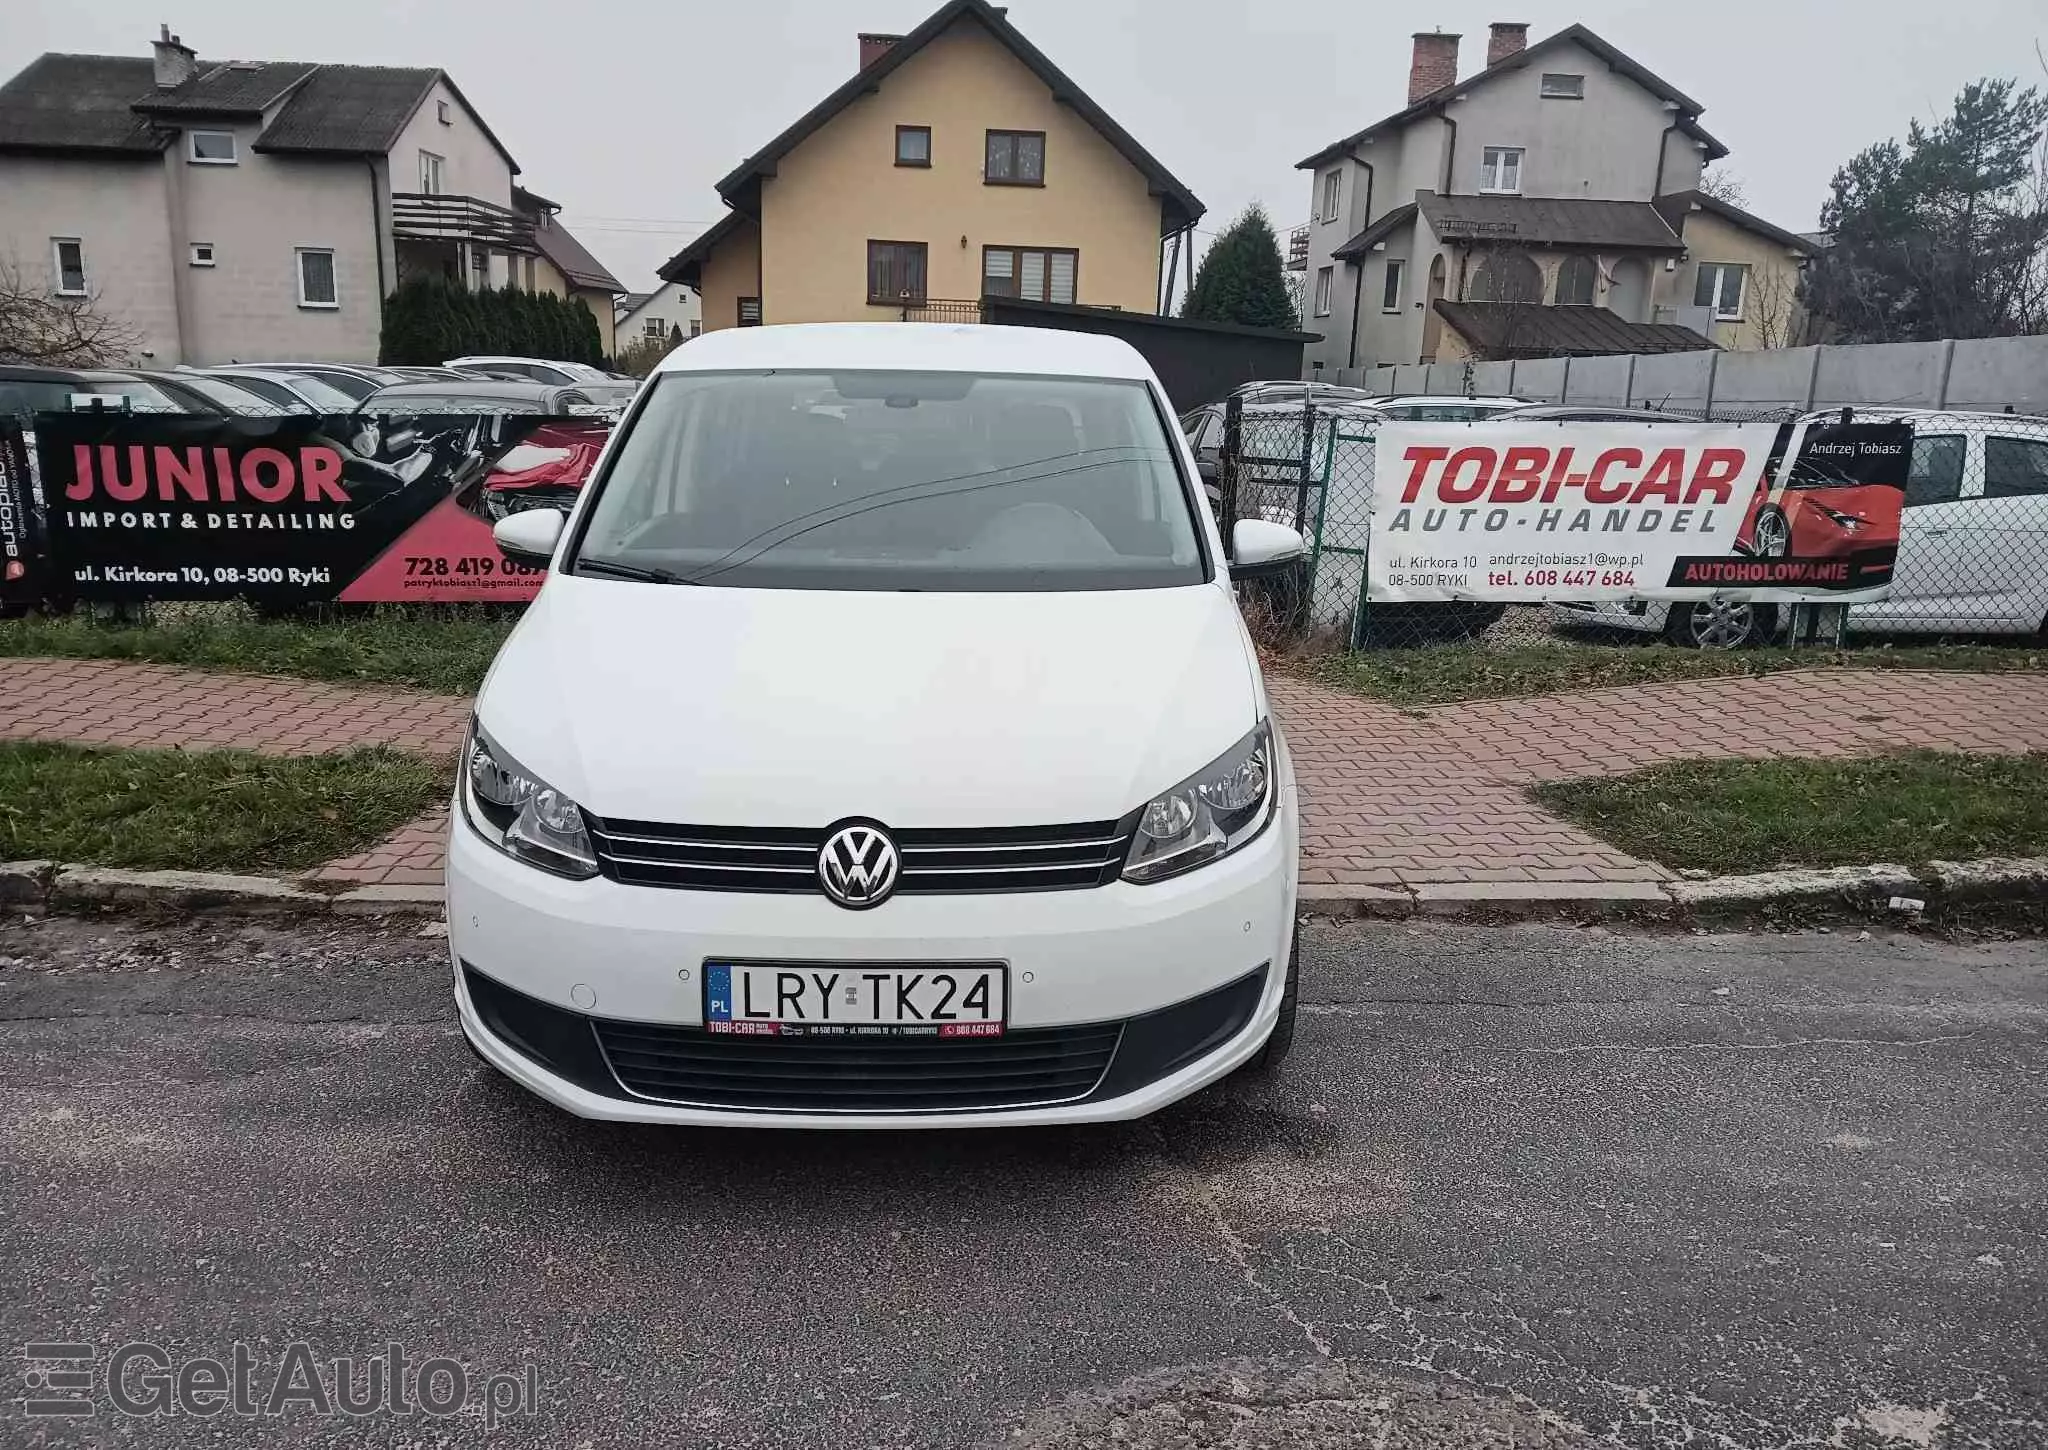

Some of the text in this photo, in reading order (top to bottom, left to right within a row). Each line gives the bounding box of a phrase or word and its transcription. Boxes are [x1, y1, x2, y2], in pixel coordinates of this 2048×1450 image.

[1810, 441, 1902, 457] Andrzej Tobiasz
[64, 444, 352, 503] JUNIOR
[1400, 446, 1746, 505] TOBI-CAR
[66, 511, 356, 530] IMPORT & DETAILING
[1388, 508, 1718, 533] AUTO-HANDEL
[404, 557, 449, 576] 728
[455, 557, 495, 576] 419
[1389, 556, 1477, 569] ul. Kirkora 10
[1488, 552, 1645, 569] andrzejtobiasz1@wp.pl
[74, 566, 331, 587] ul. Kirkora 10, 08-500 Ryki
[1388, 573, 1468, 587] 08-500 RYKI
[1488, 570, 1635, 587] tel. 608 447 684
[1684, 563, 1849, 581] AUTOHOLOWANIE
[743, 971, 990, 1020] LRY TK24
[711, 1000, 729, 1013] PL
